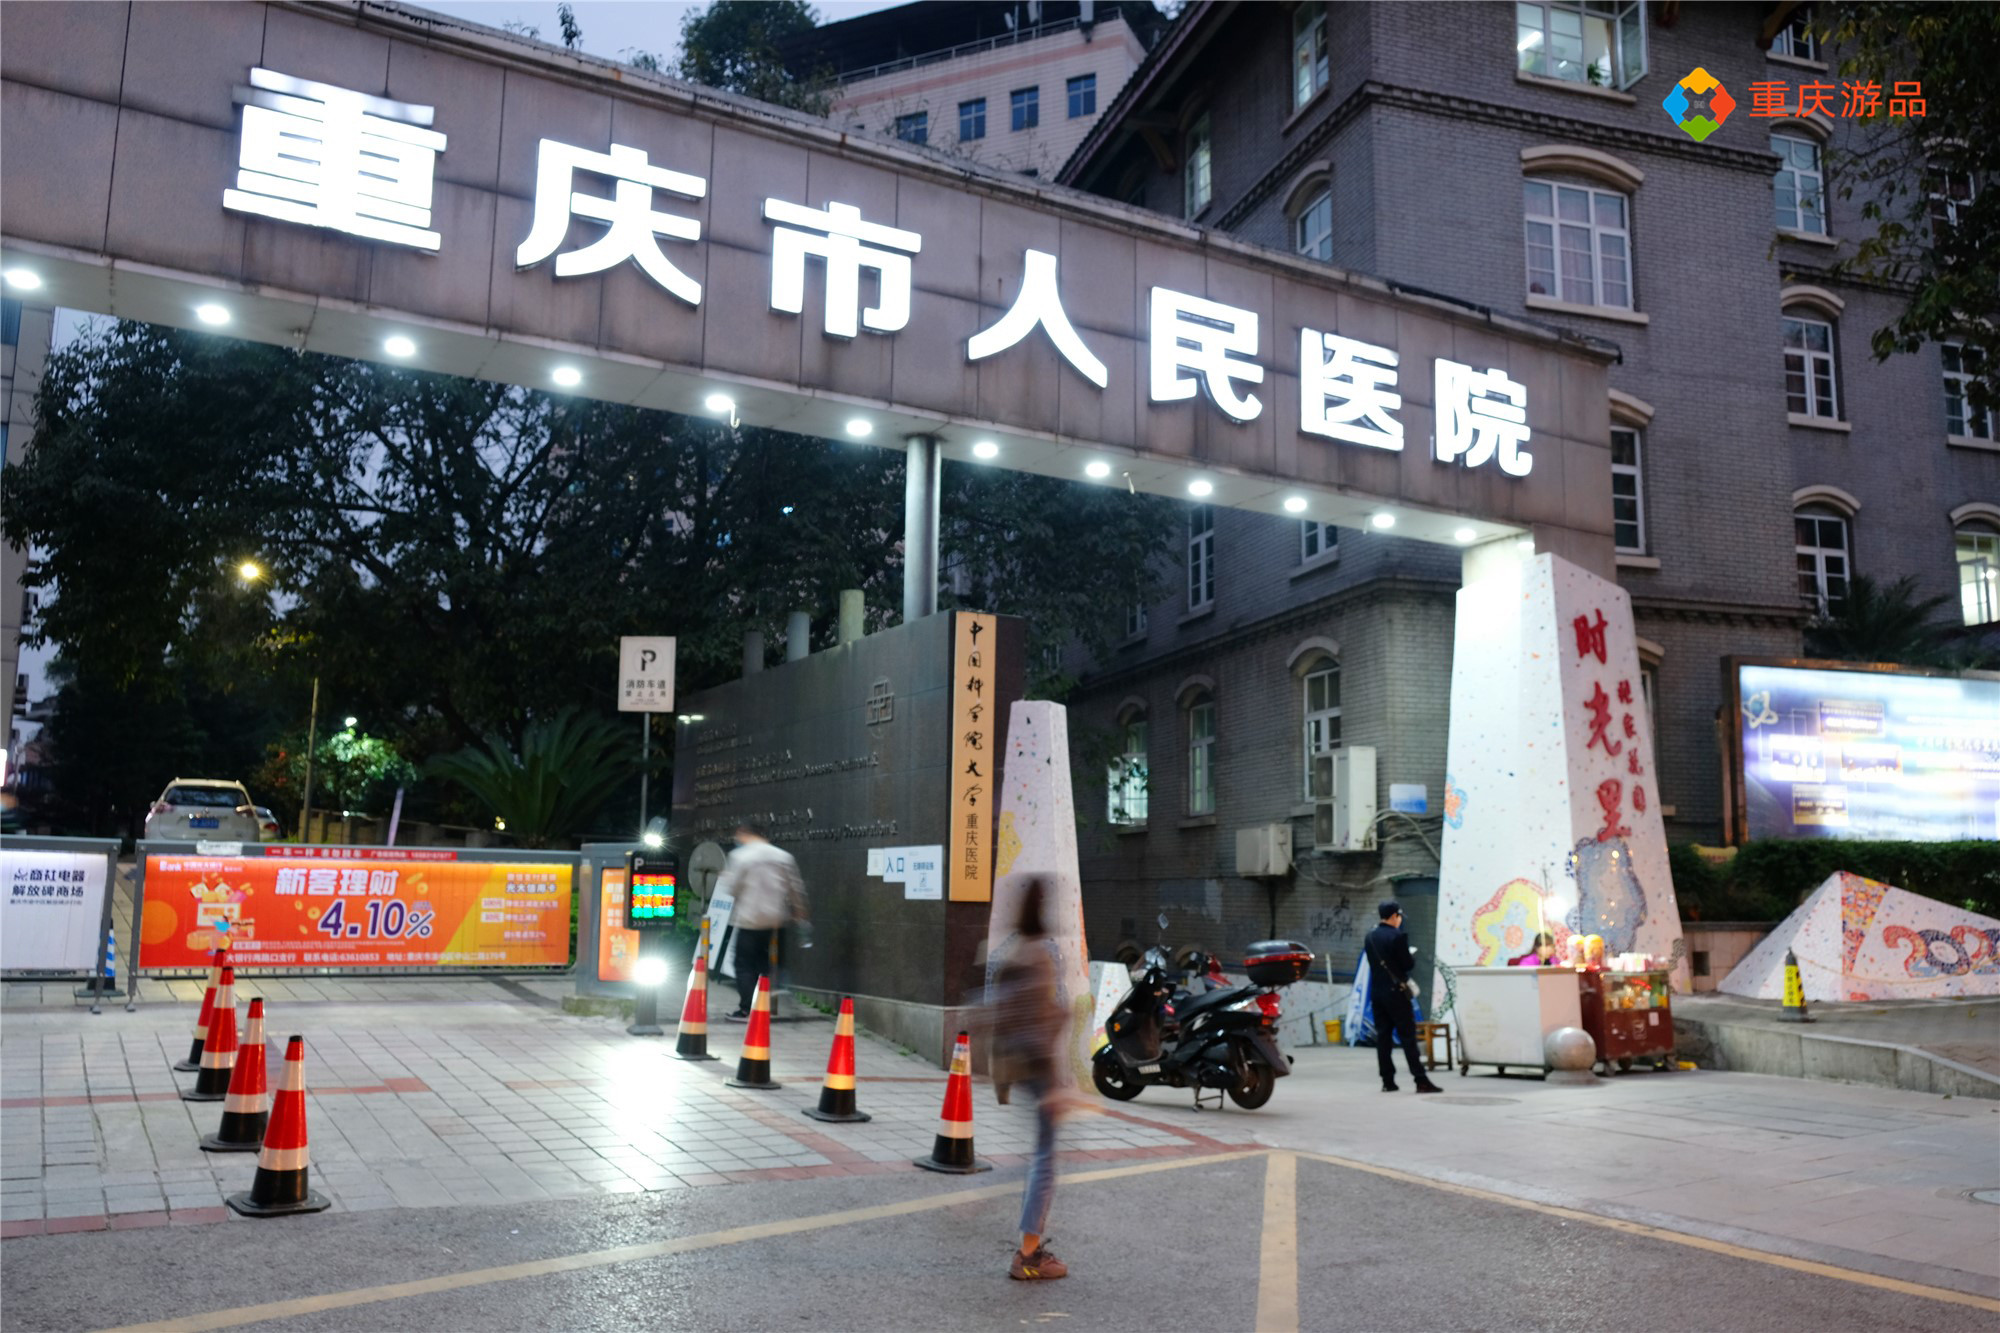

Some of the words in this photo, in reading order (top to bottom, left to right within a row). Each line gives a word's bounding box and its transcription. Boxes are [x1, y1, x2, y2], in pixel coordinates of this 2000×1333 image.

[222, 66, 1533, 478] 重庆市人民医院
[275, 868, 399, 896] 新客理财
[886, 857, 904, 873] 入口
[317, 898, 435, 939] 4.10%
